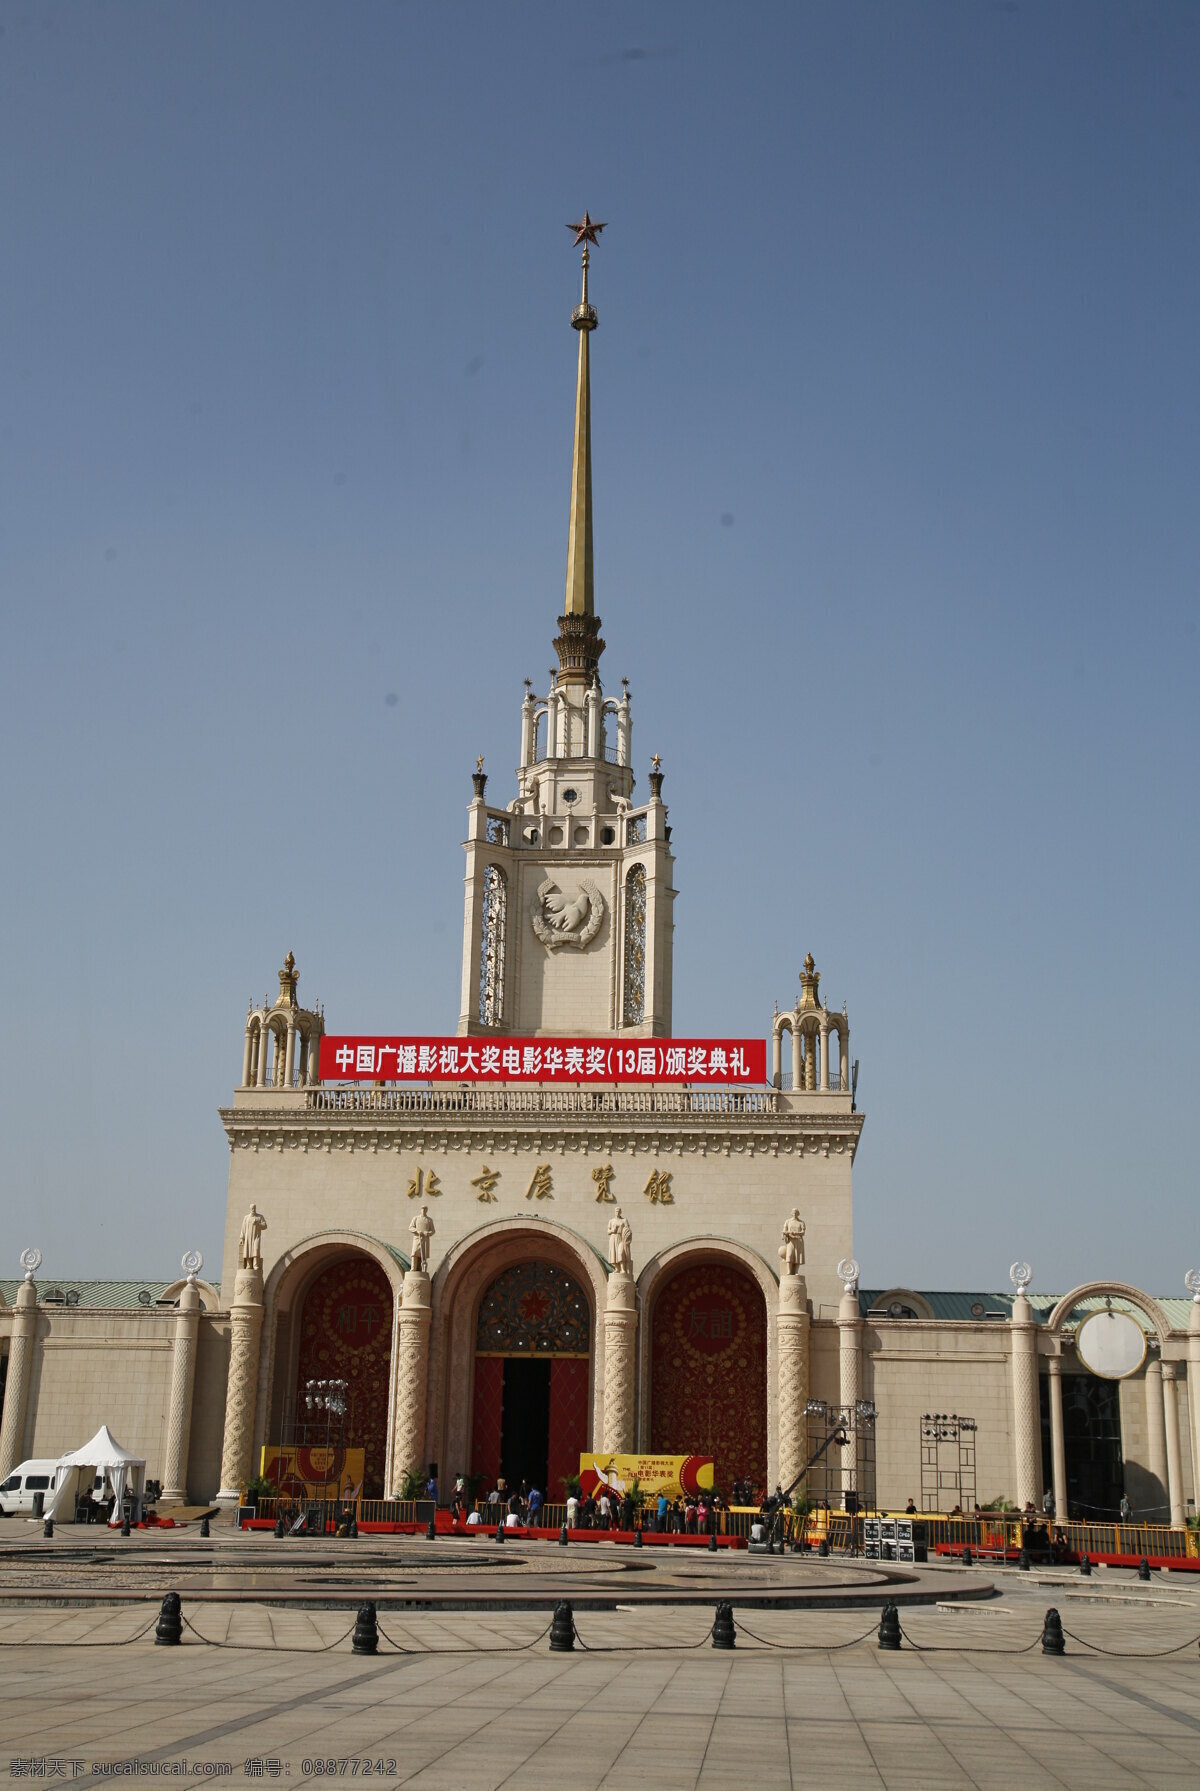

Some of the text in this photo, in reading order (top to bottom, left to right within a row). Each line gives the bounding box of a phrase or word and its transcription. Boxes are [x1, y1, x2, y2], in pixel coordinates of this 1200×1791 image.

[335, 1044, 751, 1077] 中国广播影视大奖电影华表奖(13届)颁奖典礼
[638, 1470, 674, 1478] 电影华表奖
